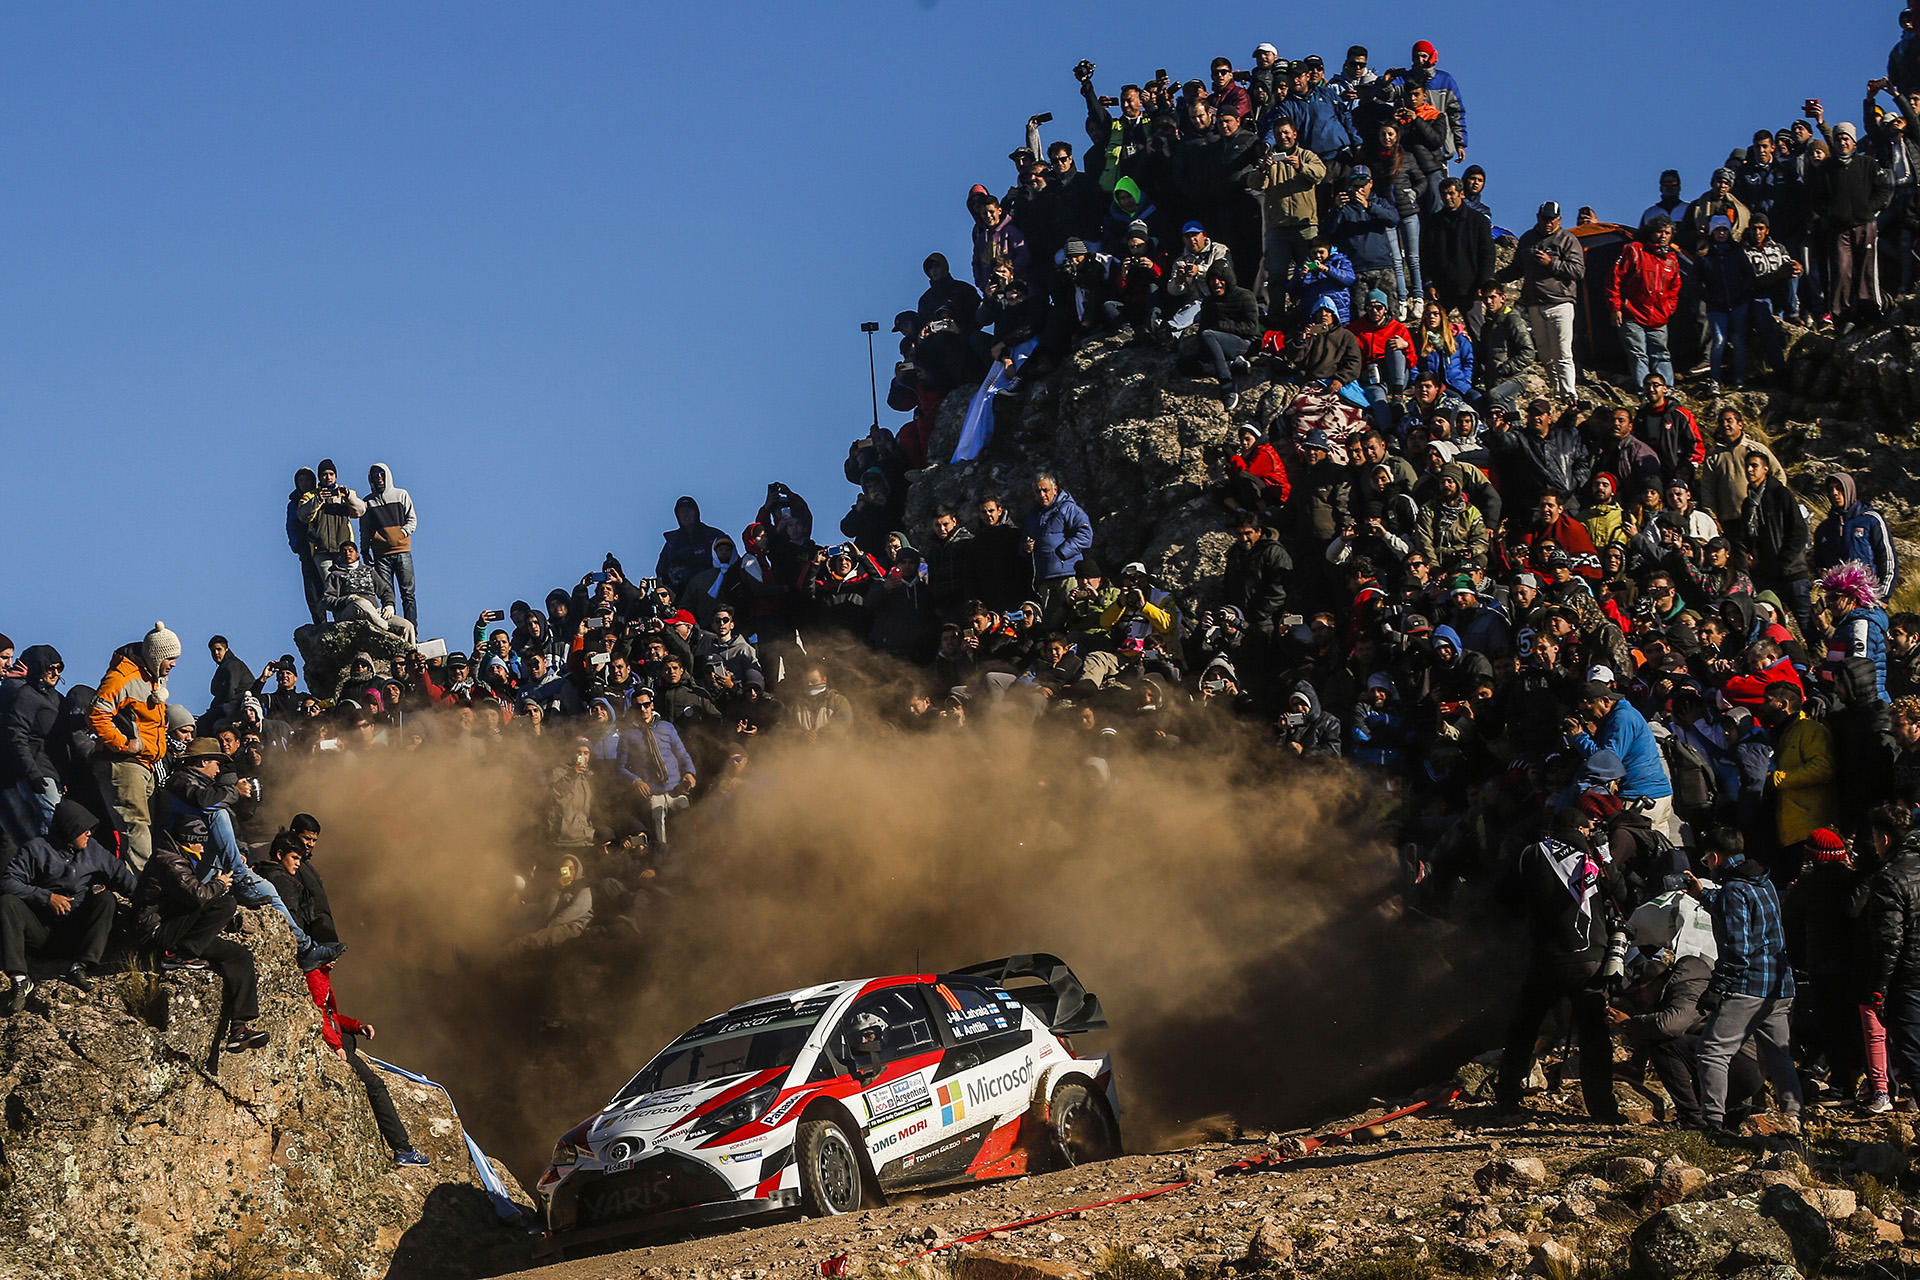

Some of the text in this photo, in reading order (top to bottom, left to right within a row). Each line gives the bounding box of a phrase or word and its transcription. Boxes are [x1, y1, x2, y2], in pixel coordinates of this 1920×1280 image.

[961, 1005, 990, 1020] Latvala
[718, 1014, 779, 1035] Lexar
[963, 1021, 990, 1036] Anttila
[893, 1083, 909, 1092] YPF
[967, 1055, 1034, 1108] Microsoft
[895, 1086, 927, 1103] Argentina
[619, 1102, 692, 1122] Microsoft
[651, 1135, 669, 1147] DMG
[690, 1129, 707, 1138] PIAA
[872, 1119, 928, 1155] DMG MORI
[915, 1132, 981, 1163] TOYOTA GAZOO Racing
